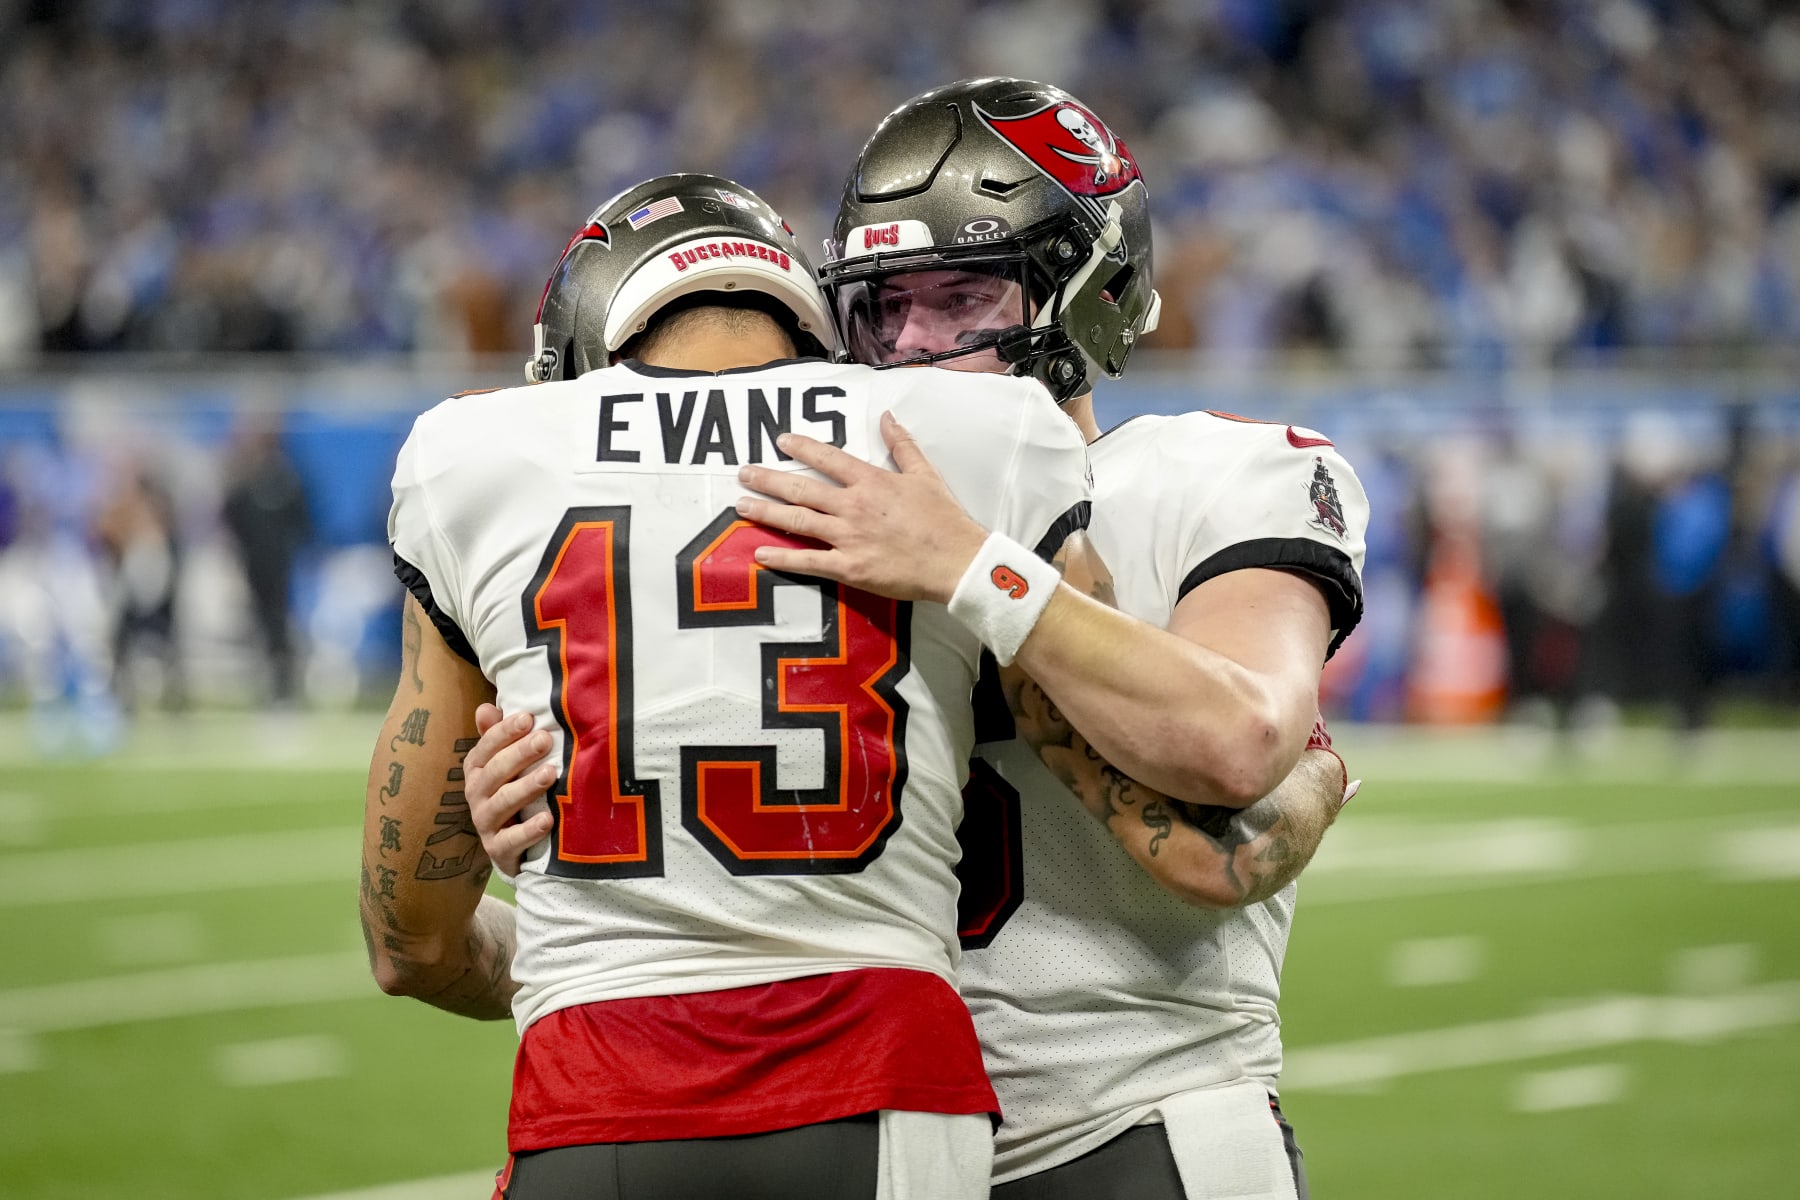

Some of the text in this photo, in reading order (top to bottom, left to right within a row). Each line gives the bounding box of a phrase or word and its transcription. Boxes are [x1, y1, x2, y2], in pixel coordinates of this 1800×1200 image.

[864, 224, 899, 250] BUCS
[957, 230, 1010, 244] OAKLEY
[668, 242, 791, 272] BUCCANEERS
[596, 386, 847, 465] EVANS
[990, 564, 1029, 600] 9
[521, 505, 912, 877] 13
